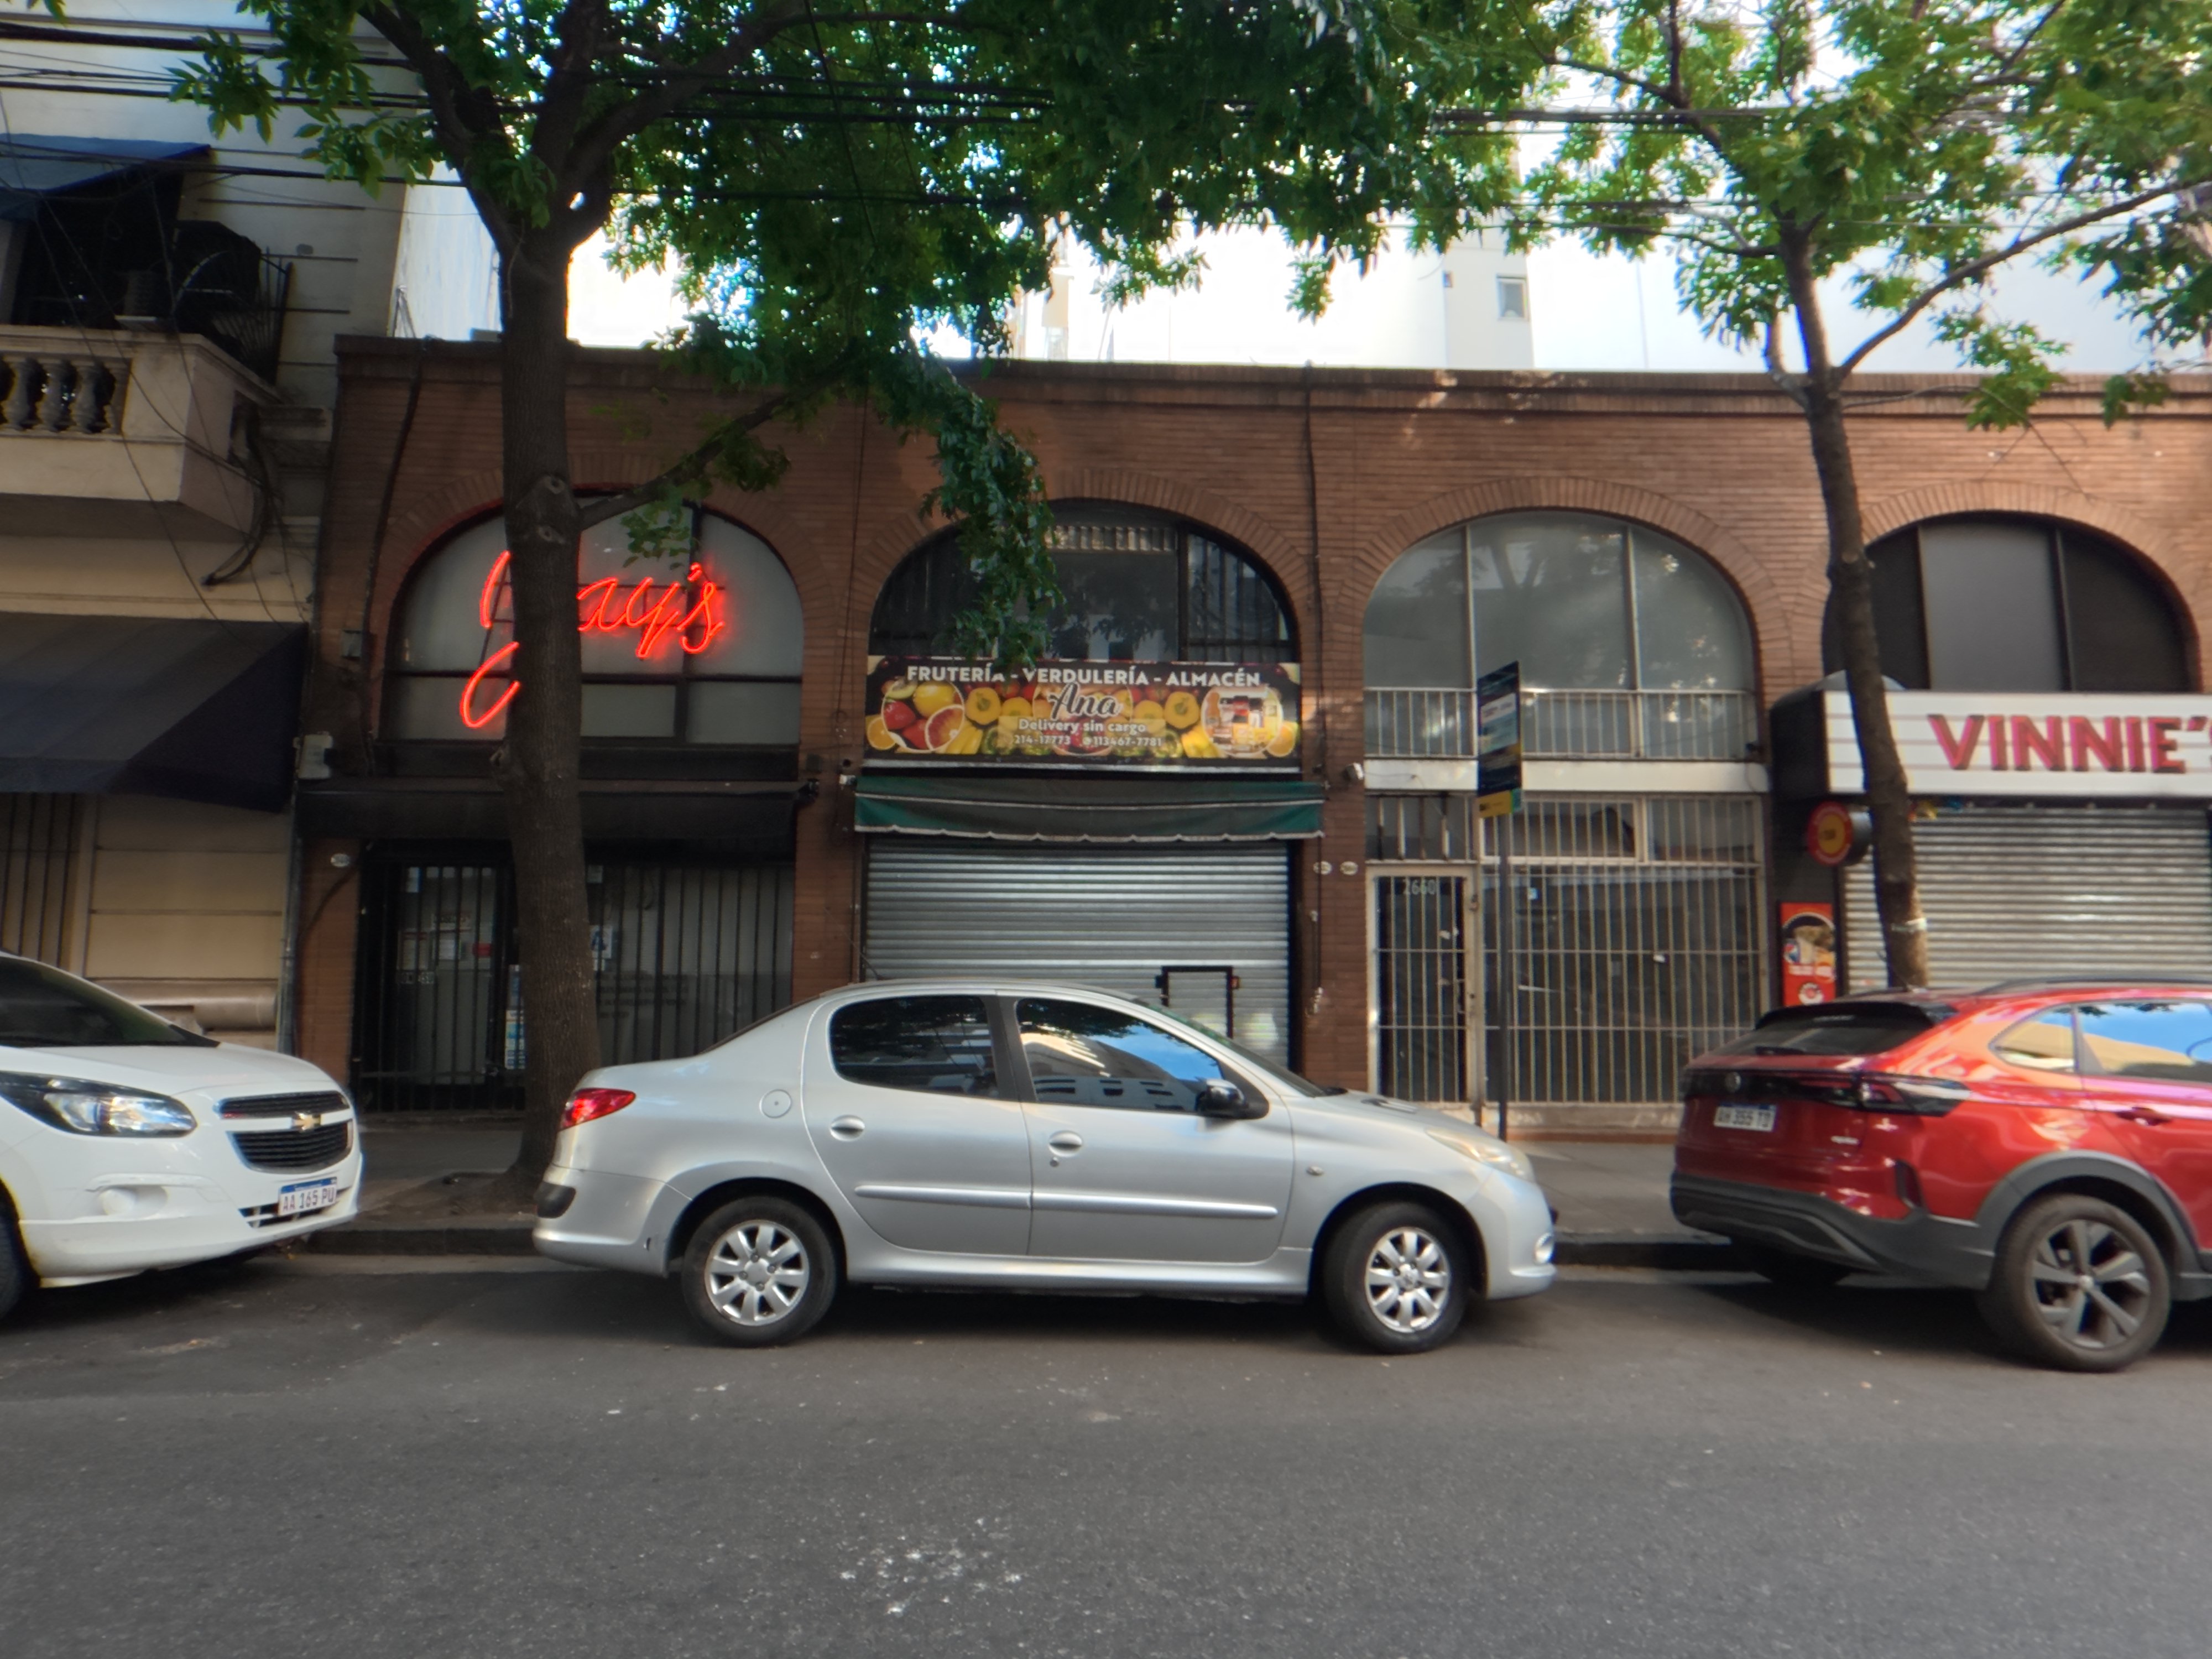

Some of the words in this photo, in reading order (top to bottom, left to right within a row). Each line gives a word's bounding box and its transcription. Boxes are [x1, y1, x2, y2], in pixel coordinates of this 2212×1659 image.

[907, 662, 1005, 682] FRUTERÍA
[1022, 665, 1149, 685] VERDULERÍA
[1166, 667, 1260, 687] ALMACÉN
[1047, 681, 1123, 721] Ana
[1019, 718, 1079, 732] Delivery
[1083, 719, 1104, 732] sin
[1108, 722, 1146, 737] cargo
[1926, 713, 2212, 774] VINNIE'
[283, 1195, 295, 1212] AA
[299, 1190, 319, 1209] 165
[321, 1187, 335, 1204] PU
